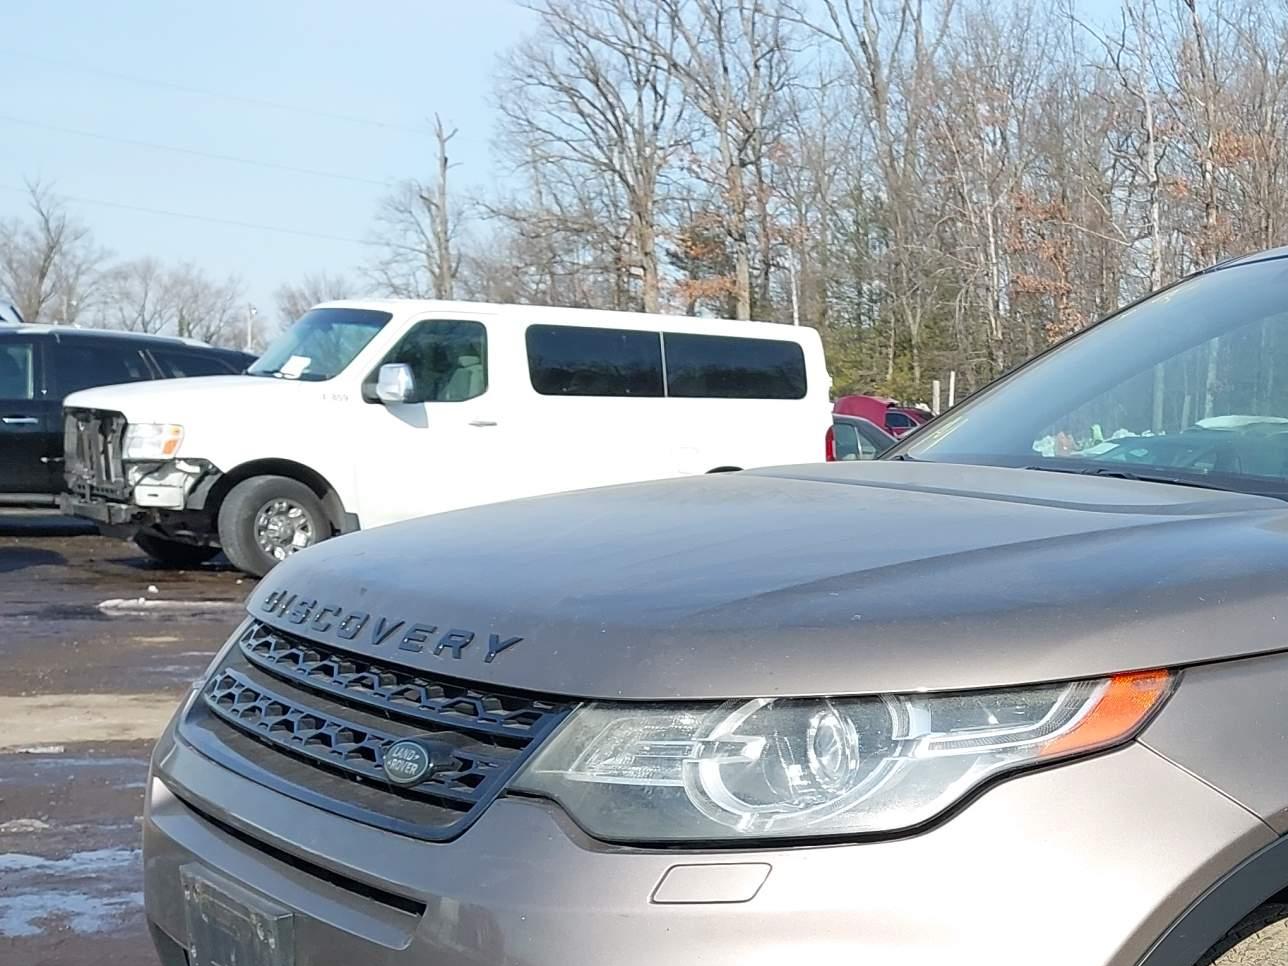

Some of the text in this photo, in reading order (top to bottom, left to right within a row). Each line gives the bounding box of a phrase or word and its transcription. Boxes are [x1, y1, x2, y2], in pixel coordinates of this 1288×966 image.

[261, 590, 525, 664] DISCOVERY
[392, 747, 416, 760] LAND
[390, 758, 418, 775] ROVER
